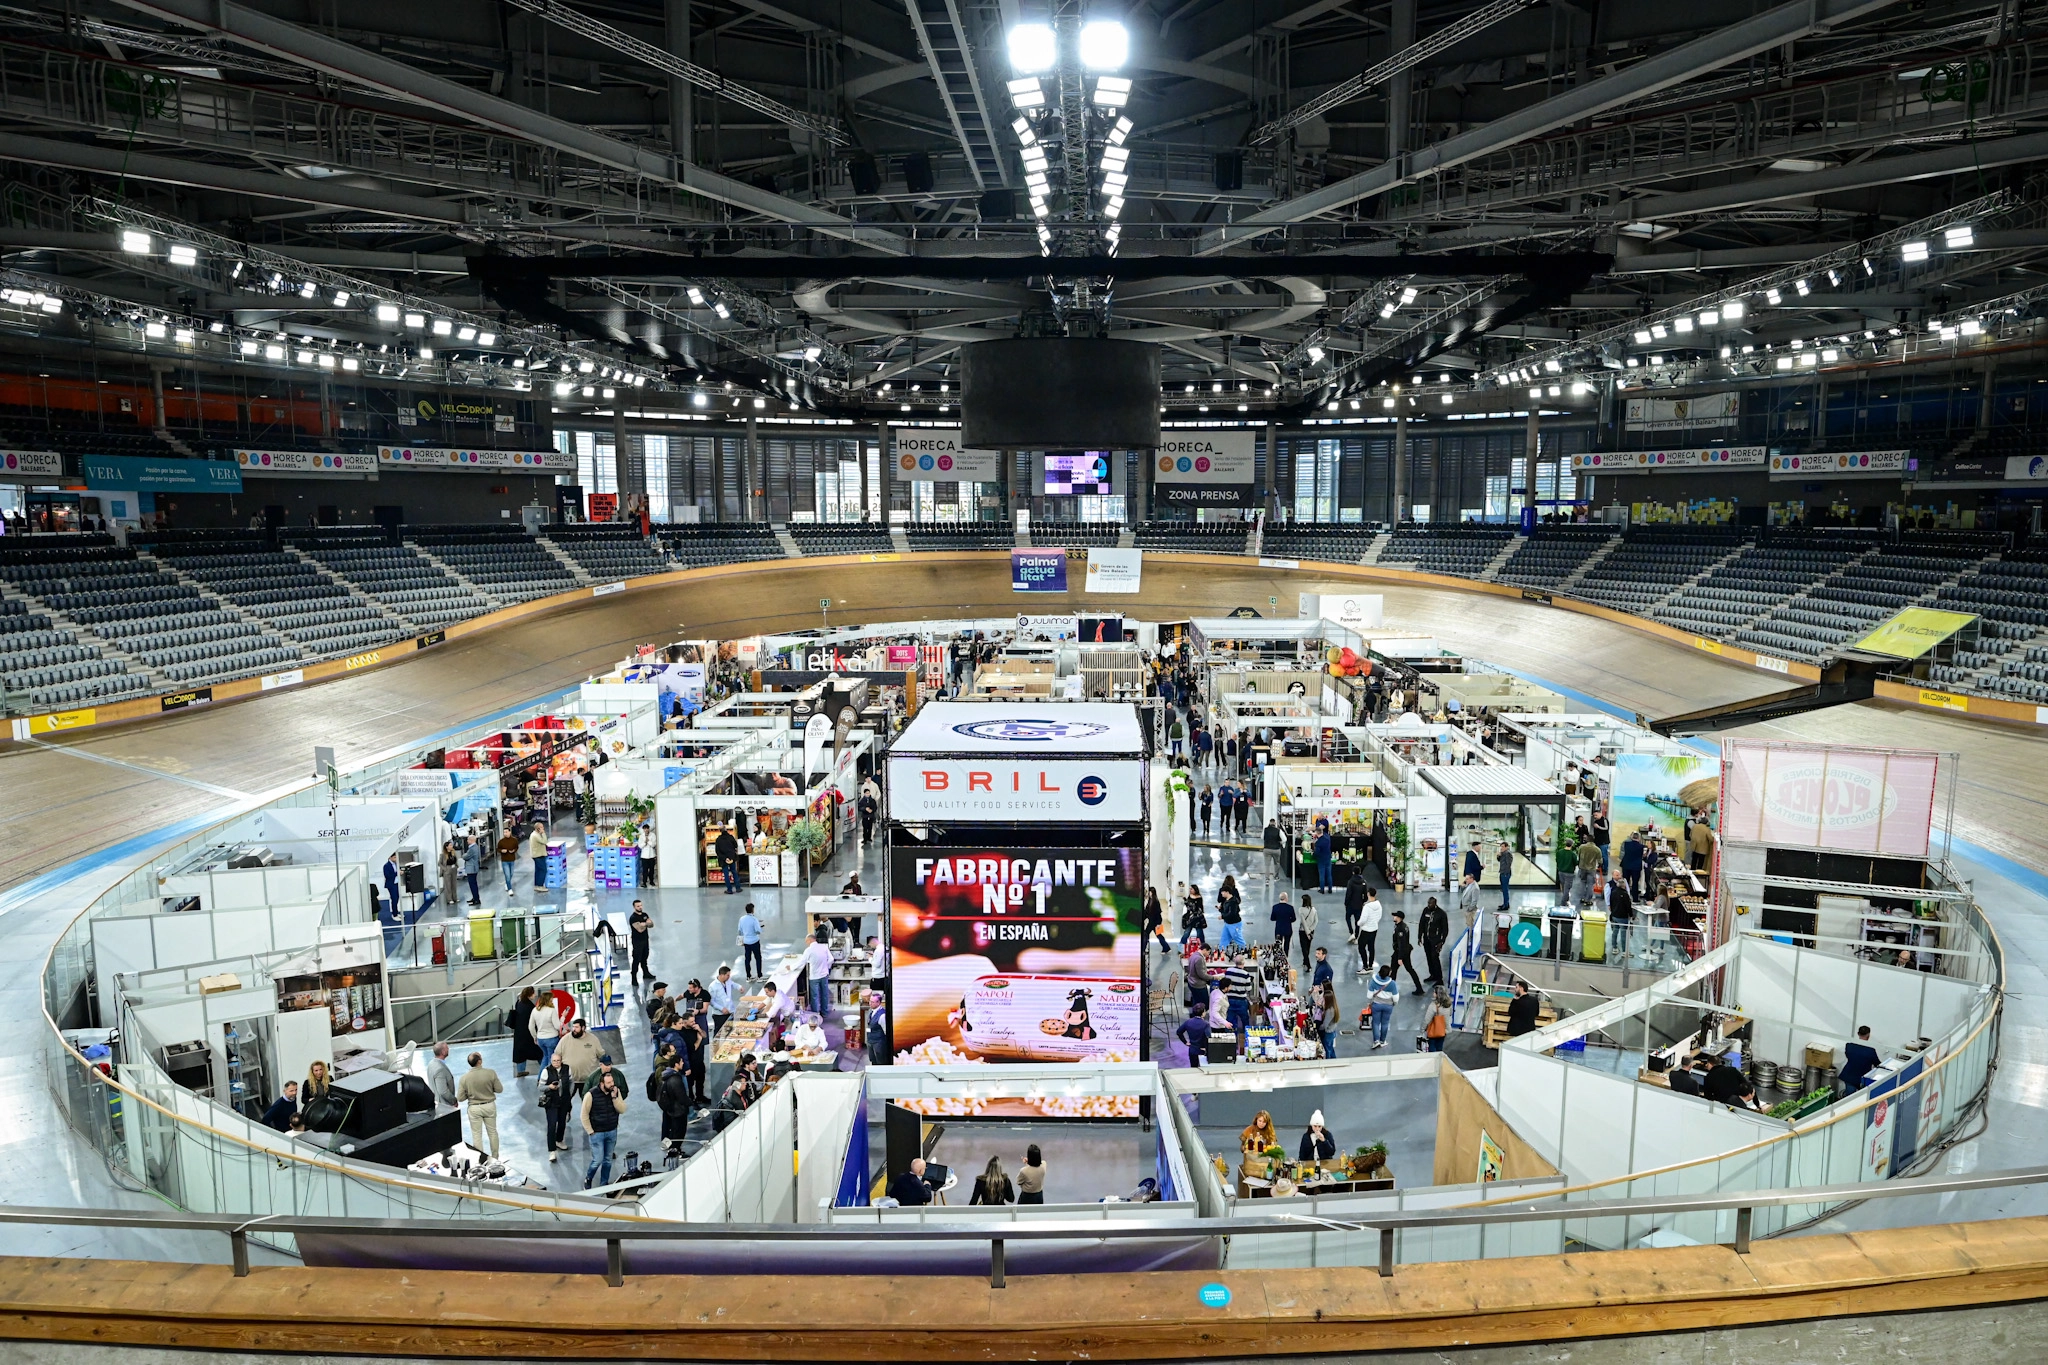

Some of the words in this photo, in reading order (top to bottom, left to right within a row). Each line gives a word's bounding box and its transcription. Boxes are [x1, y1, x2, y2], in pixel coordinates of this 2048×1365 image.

[414, 450, 445, 458] HORECA
[479, 452, 508, 460] HORECA
[1667, 452, 1696, 460] HORECA
[1731, 449, 1763, 457] HORECA
[1871, 453, 1906, 462] HORECA
[20, 454, 57, 465] HORECA
[273, 454, 307, 463] HORECA
[344, 456, 374, 465] HORECA
[1603, 454, 1633, 462] HORECA
[1802, 456, 1833, 465] HORECA
[88, 467, 124, 480] VERA
[209, 468, 238, 480] VERA
[1169, 491, 1198, 500] ZONA
[1201, 491, 1240, 500] PRENSA
[1020, 557, 1058, 566] Palma
[808, 647, 861, 672] etika
[922, 771, 1060, 793] BRIL
[923, 801, 967, 809] QUALITY
[974, 801, 1001, 809] FOOD
[1008, 801, 1061, 809] SERVICES
[317, 829, 350, 838] SERCAT
[351, 827, 389, 837] Renting
[915, 858, 1116, 886] FABRICANTE
[982, 883, 1024, 914] Nº
[1031, 883, 1046, 914] 1
[980, 924, 995, 940] EN
[1000, 922, 1048, 941] ESPAÑA
[1517, 929, 1532, 949] 4
[975, 990, 1013, 998] NAPOLI
[1100, 994, 1140, 1003] NAPOLI
